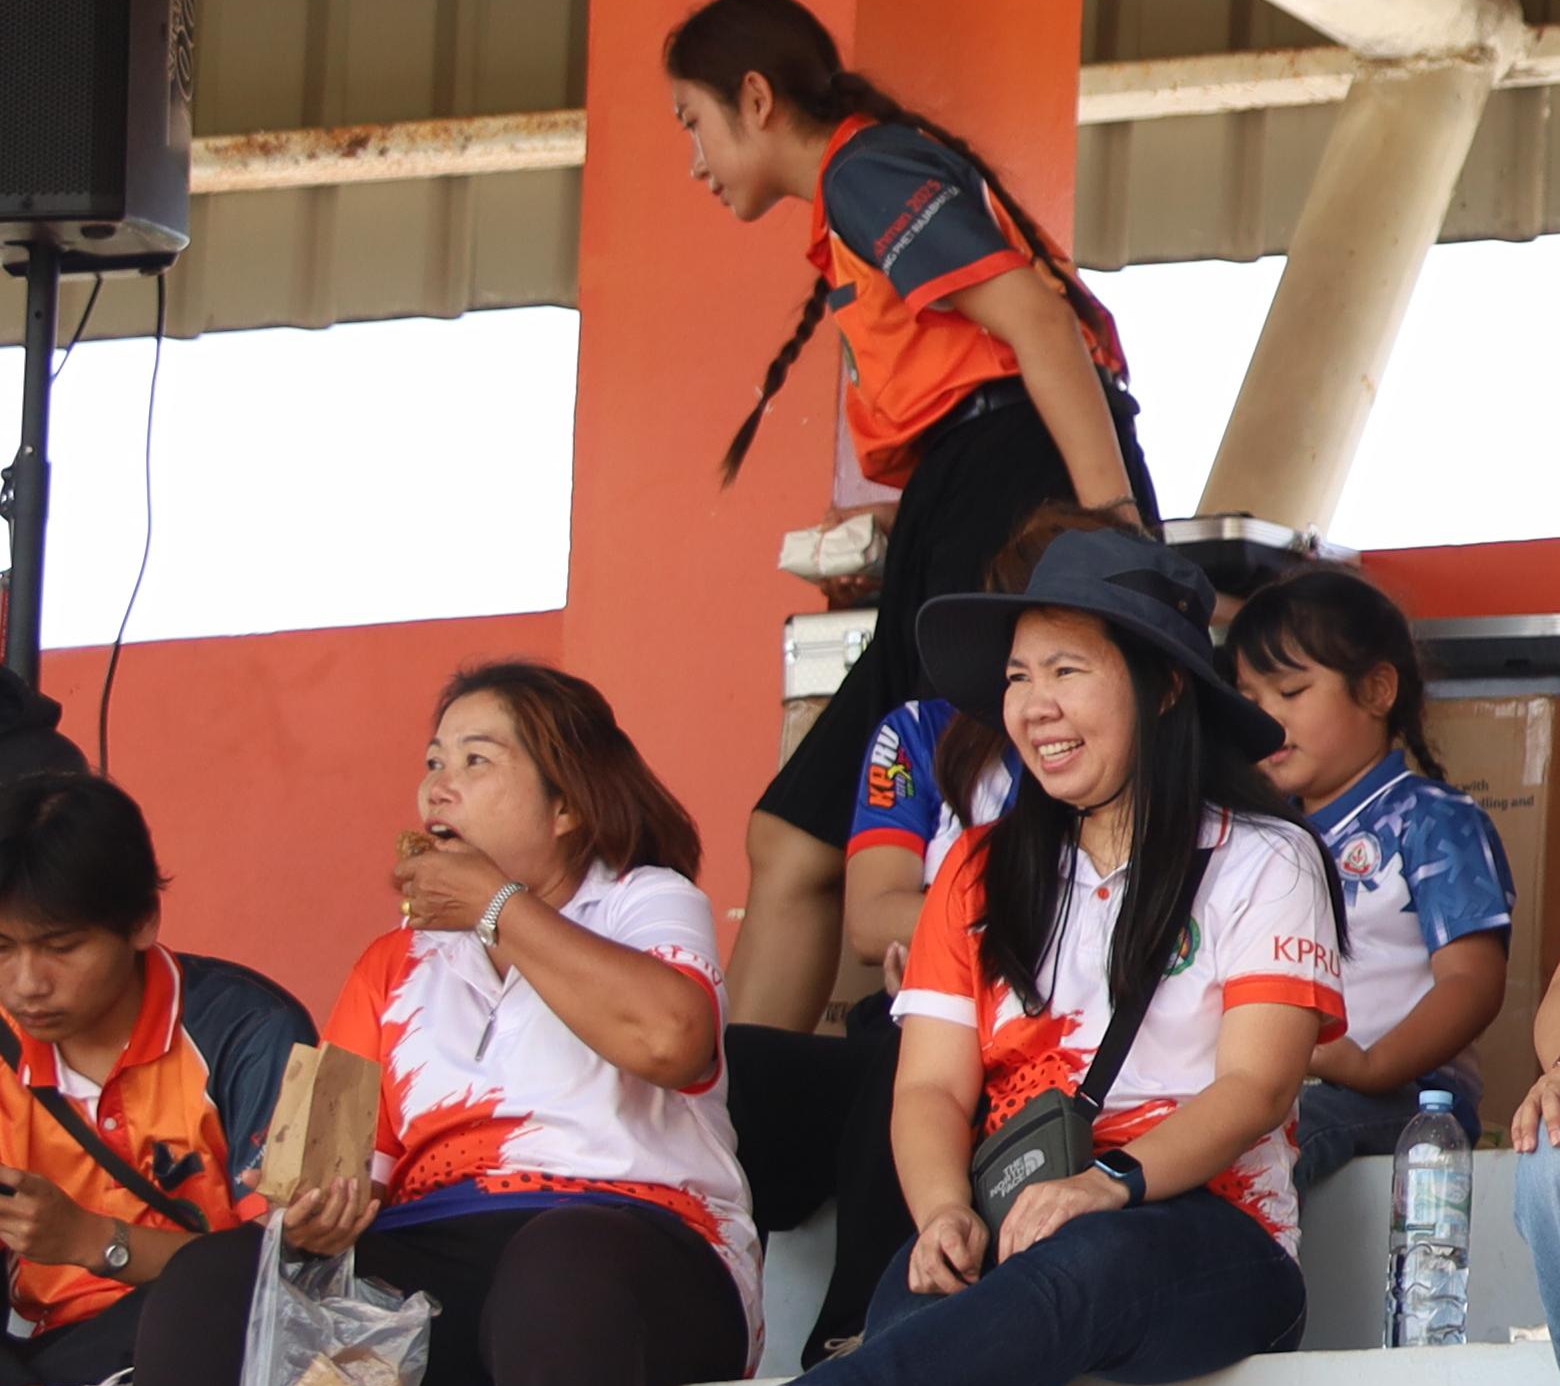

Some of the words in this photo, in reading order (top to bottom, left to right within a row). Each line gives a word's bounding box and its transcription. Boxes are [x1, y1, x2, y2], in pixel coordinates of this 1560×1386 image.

[869, 724, 900, 809] KPRU
[1512, 794, 1535, 807] and
[1273, 935, 1341, 978] KPRU
